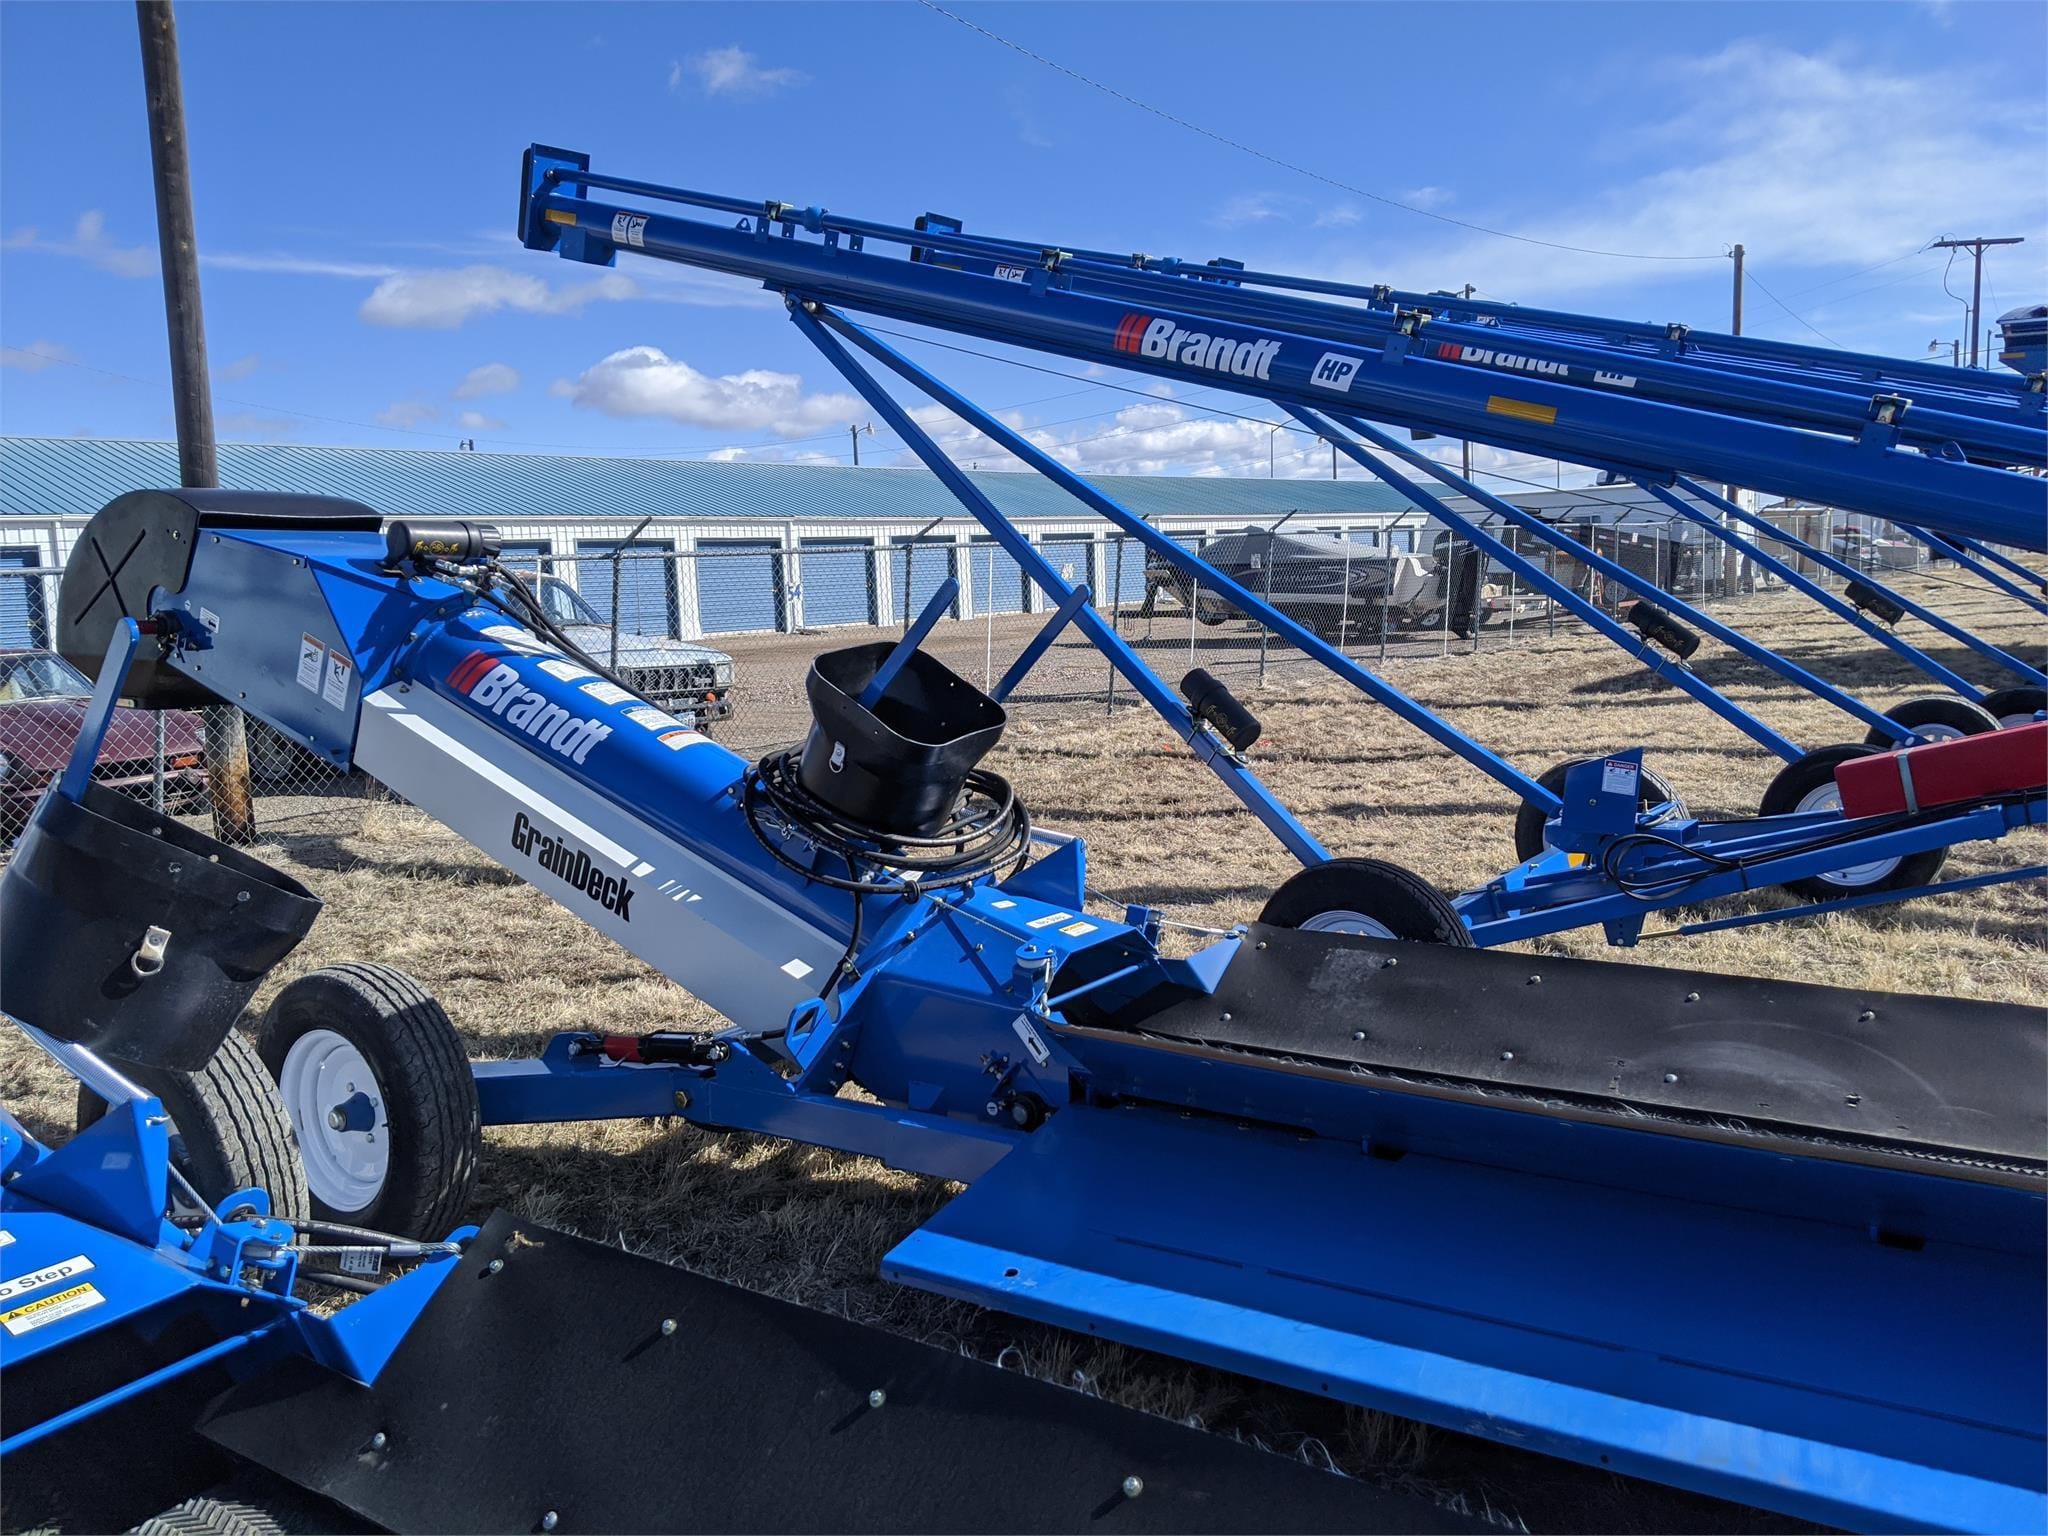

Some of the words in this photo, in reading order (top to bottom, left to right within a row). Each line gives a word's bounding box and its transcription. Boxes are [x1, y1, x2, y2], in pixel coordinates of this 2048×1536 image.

[1141, 318, 1282, 381] Brandt
[1318, 359, 1354, 383] HP
[469, 664, 613, 765] Brandt
[511, 811, 635, 923] GrainDeck
[0, 1287, 13, 1297] o
[18, 1266, 73, 1289] Step
[24, 1286, 88, 1314] CAUTION
